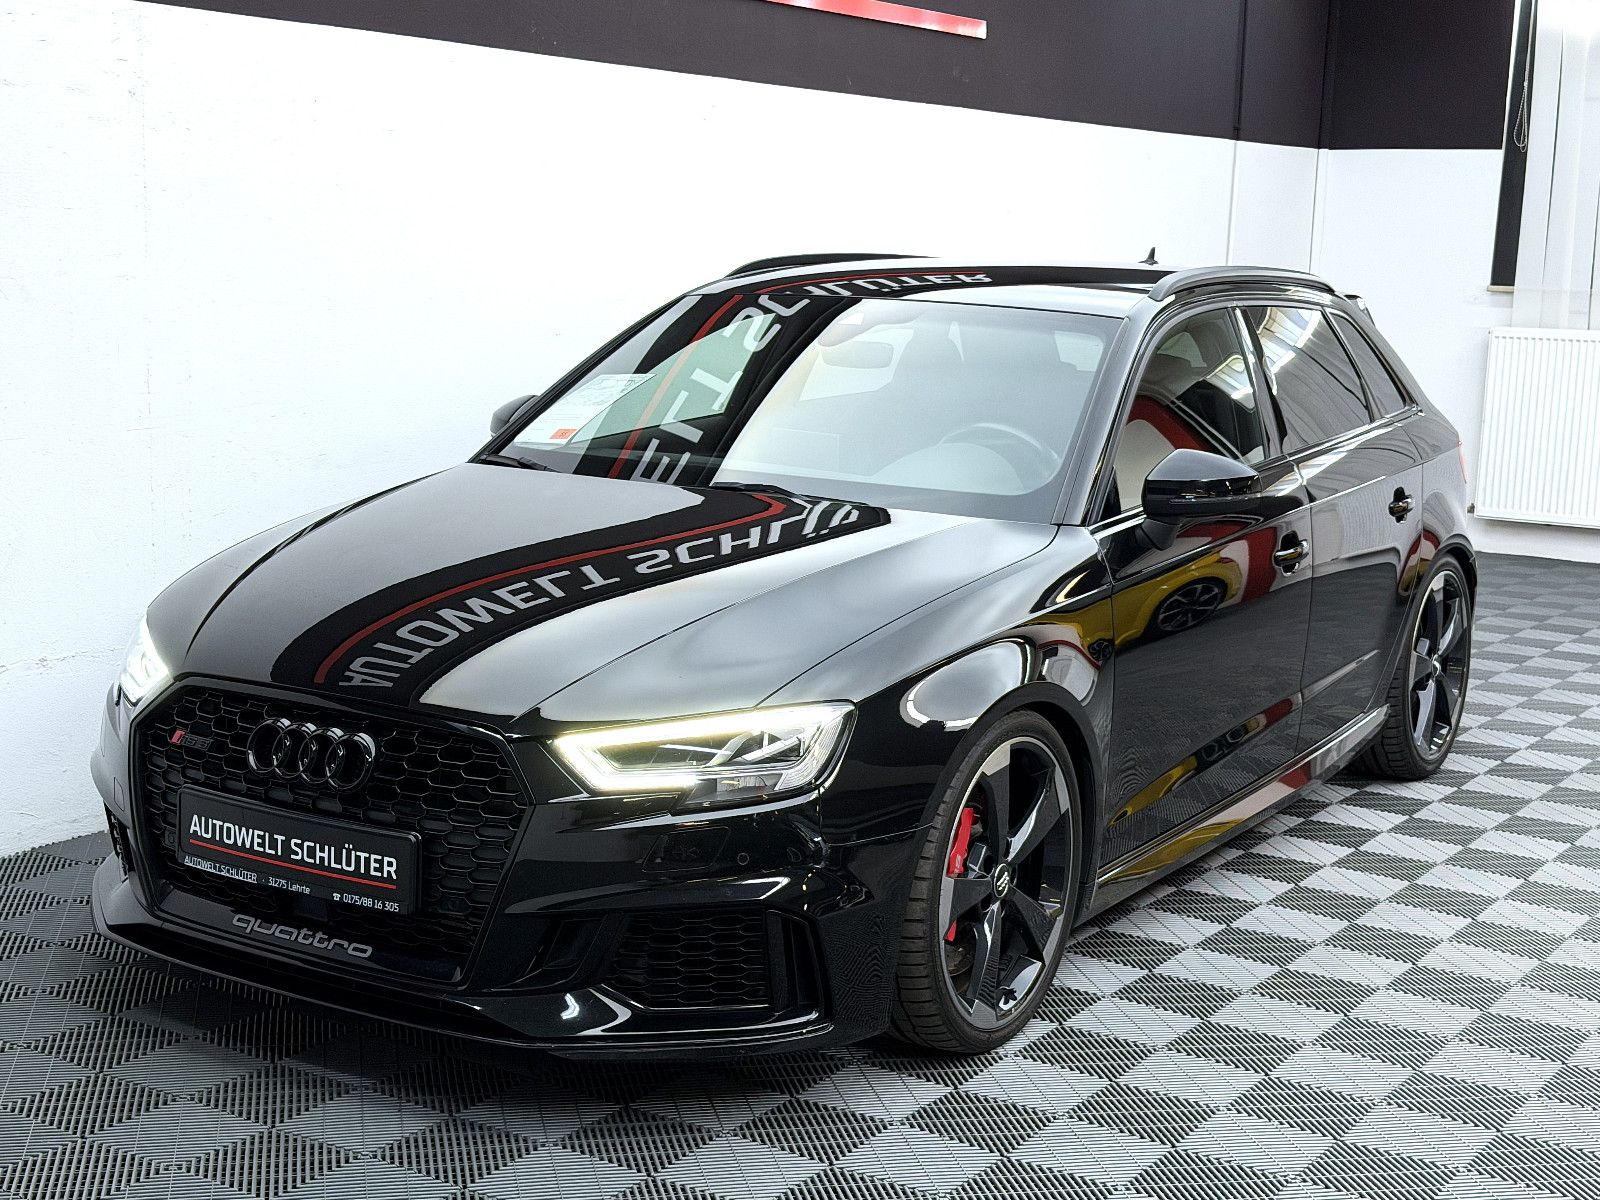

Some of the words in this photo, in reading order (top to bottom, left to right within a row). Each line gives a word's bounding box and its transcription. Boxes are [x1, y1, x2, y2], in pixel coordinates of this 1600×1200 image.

[189, 813, 286, 856] AUTOWELT
[290, 838, 397, 880] SCHLÜTER
[184, 855, 220, 874] AUTOWELT
[221, 865, 258, 883] SCHLÜTER
[268, 876, 287, 889] 31275
[288, 881, 311, 895] Lehrte
[342, 893, 373, 908] 0175/88
[374, 899, 383, 910] 16
[384, 901, 400, 913] 305
[232, 913, 373, 958] quattro
